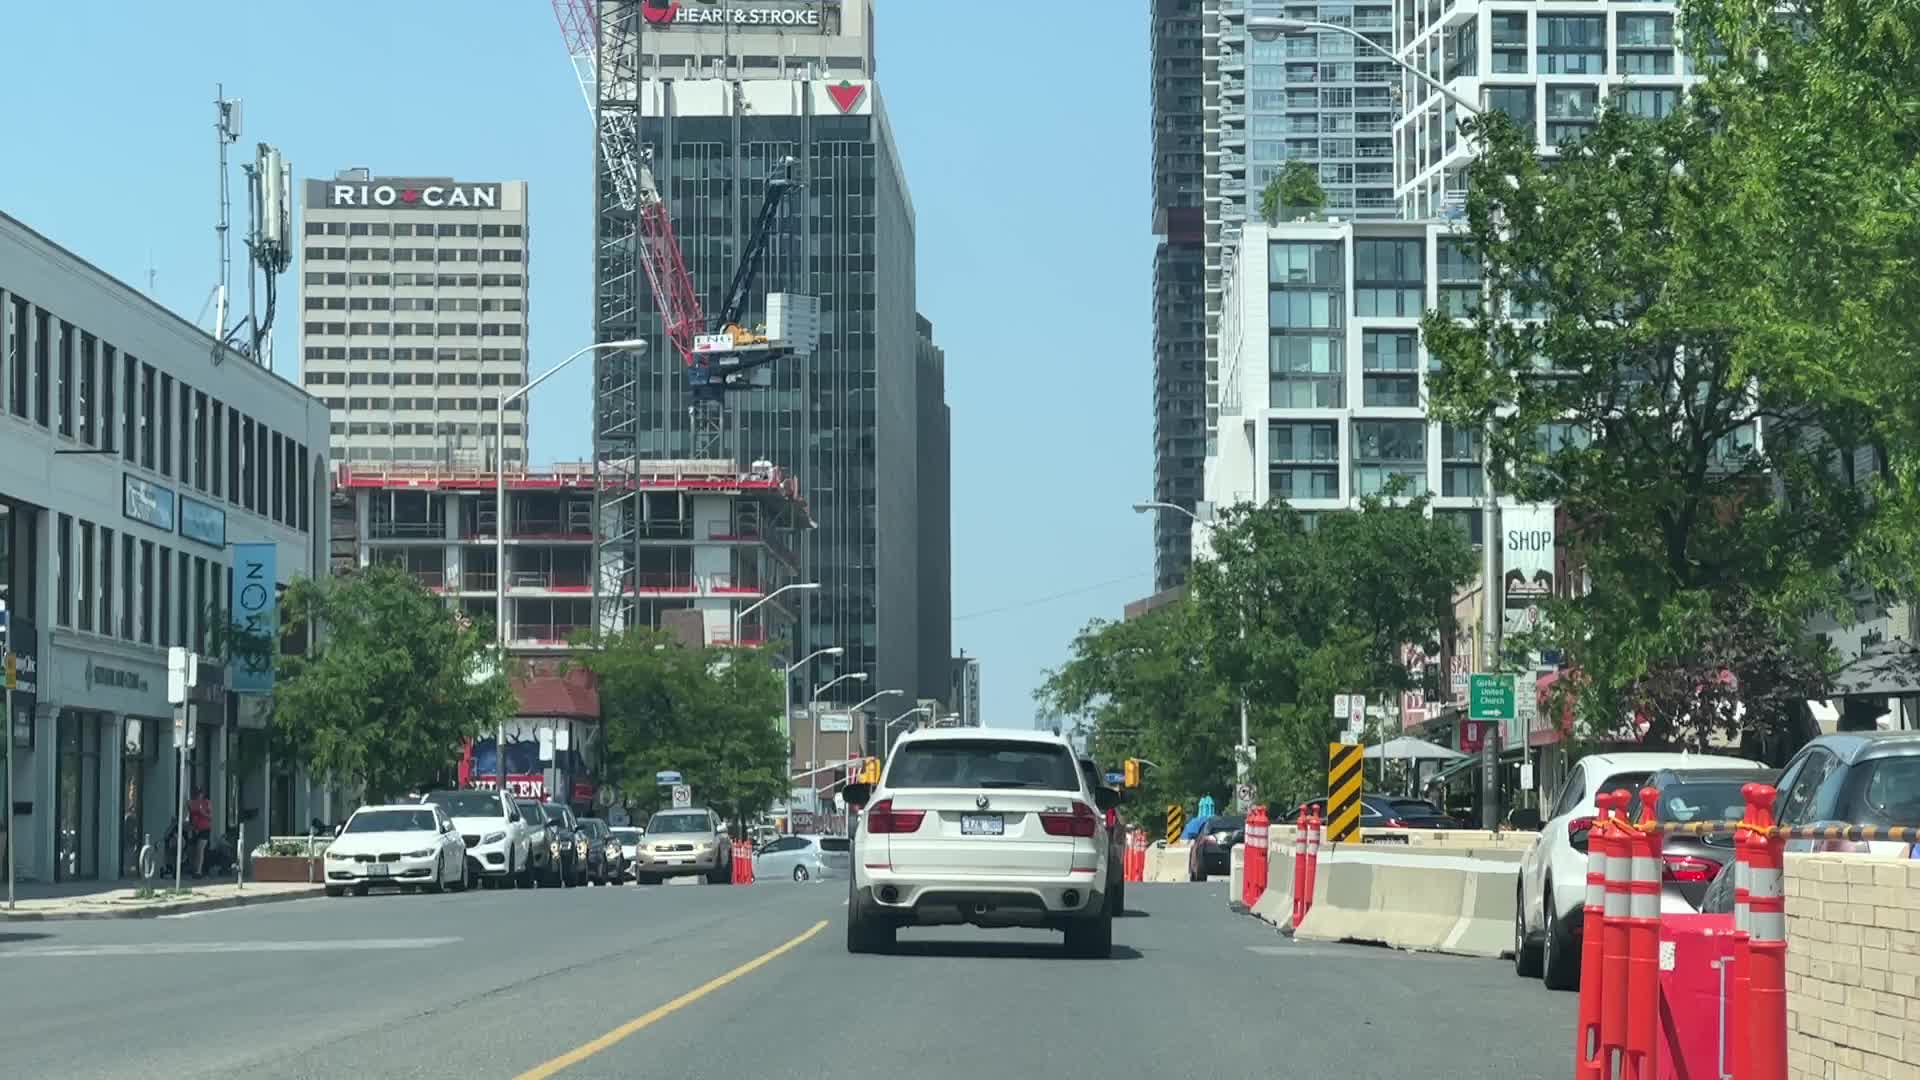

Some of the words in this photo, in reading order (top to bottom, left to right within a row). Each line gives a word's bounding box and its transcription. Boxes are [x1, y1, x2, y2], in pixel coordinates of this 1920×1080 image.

[335, 185, 397, 206] RIO
[422, 186, 496, 207] CAN
[1508, 530, 1552, 551] SHOP
[1481, 688, 1504, 696] United
[1480, 697, 1505, 705] Church
